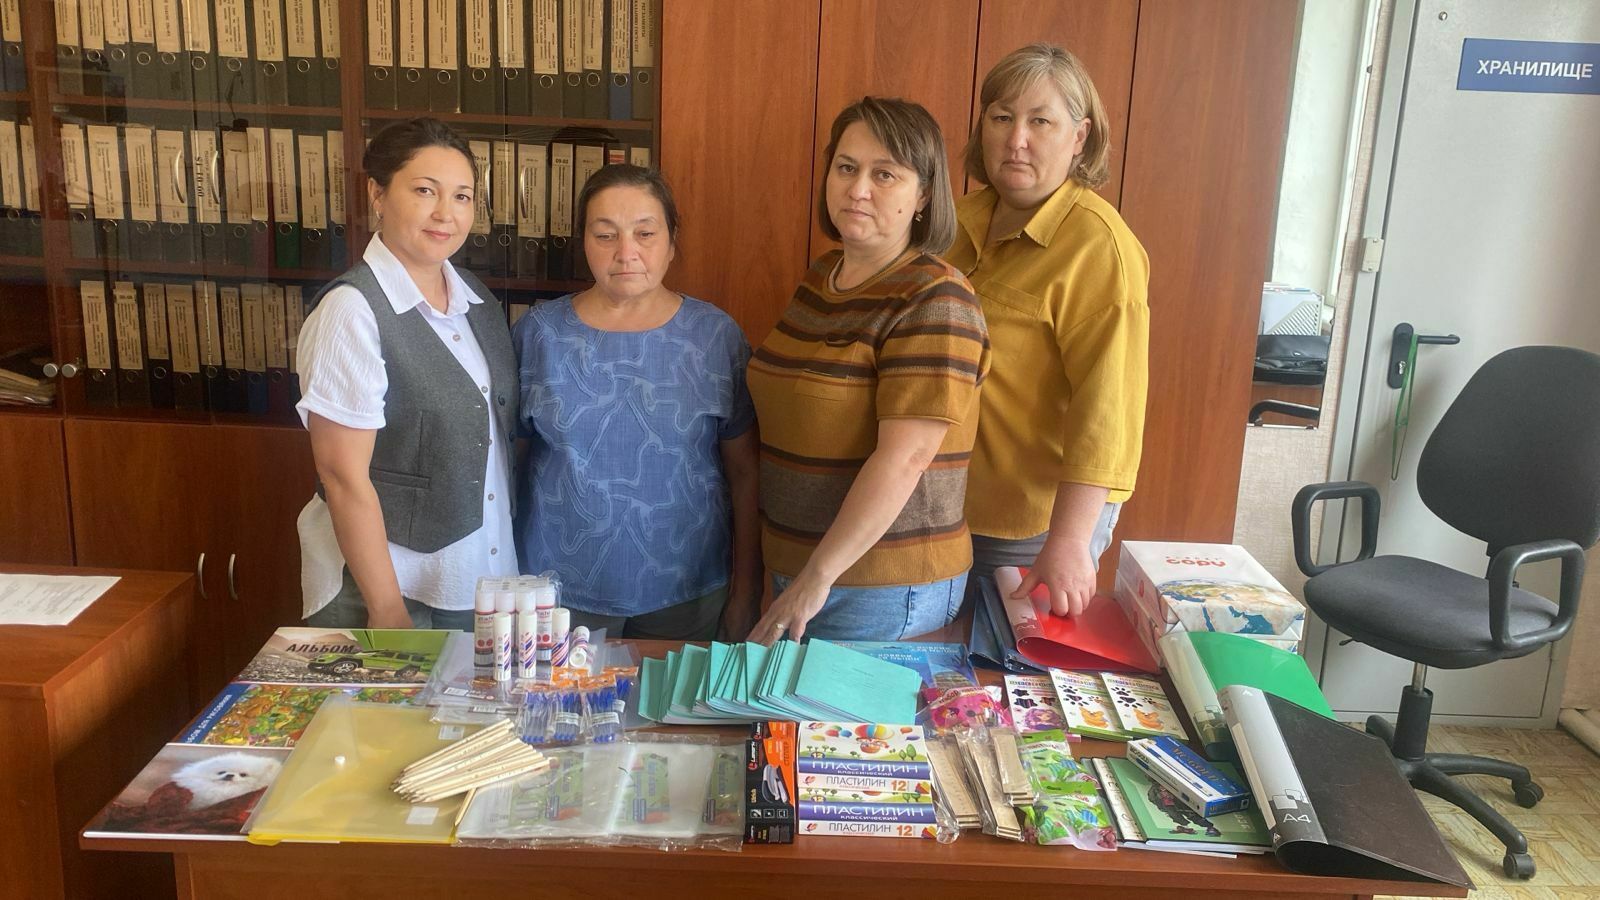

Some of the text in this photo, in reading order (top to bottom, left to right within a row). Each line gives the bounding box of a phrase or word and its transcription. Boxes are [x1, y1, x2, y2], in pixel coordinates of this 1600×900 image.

[1477, 59, 1594, 80] ХРАНИЛИЩЕ
[286, 643, 355, 653] АЛЬБОМ
[811, 760, 919, 773] ПЛАСТИЛИН
[825, 776, 908, 792] ПЛАСТИЛИН 12
[813, 804, 924, 817] ПЛАСТИЛИН
[1282, 813, 1312, 823] A4
[829, 823, 913, 836] ПЛАСТИЛИН 12
